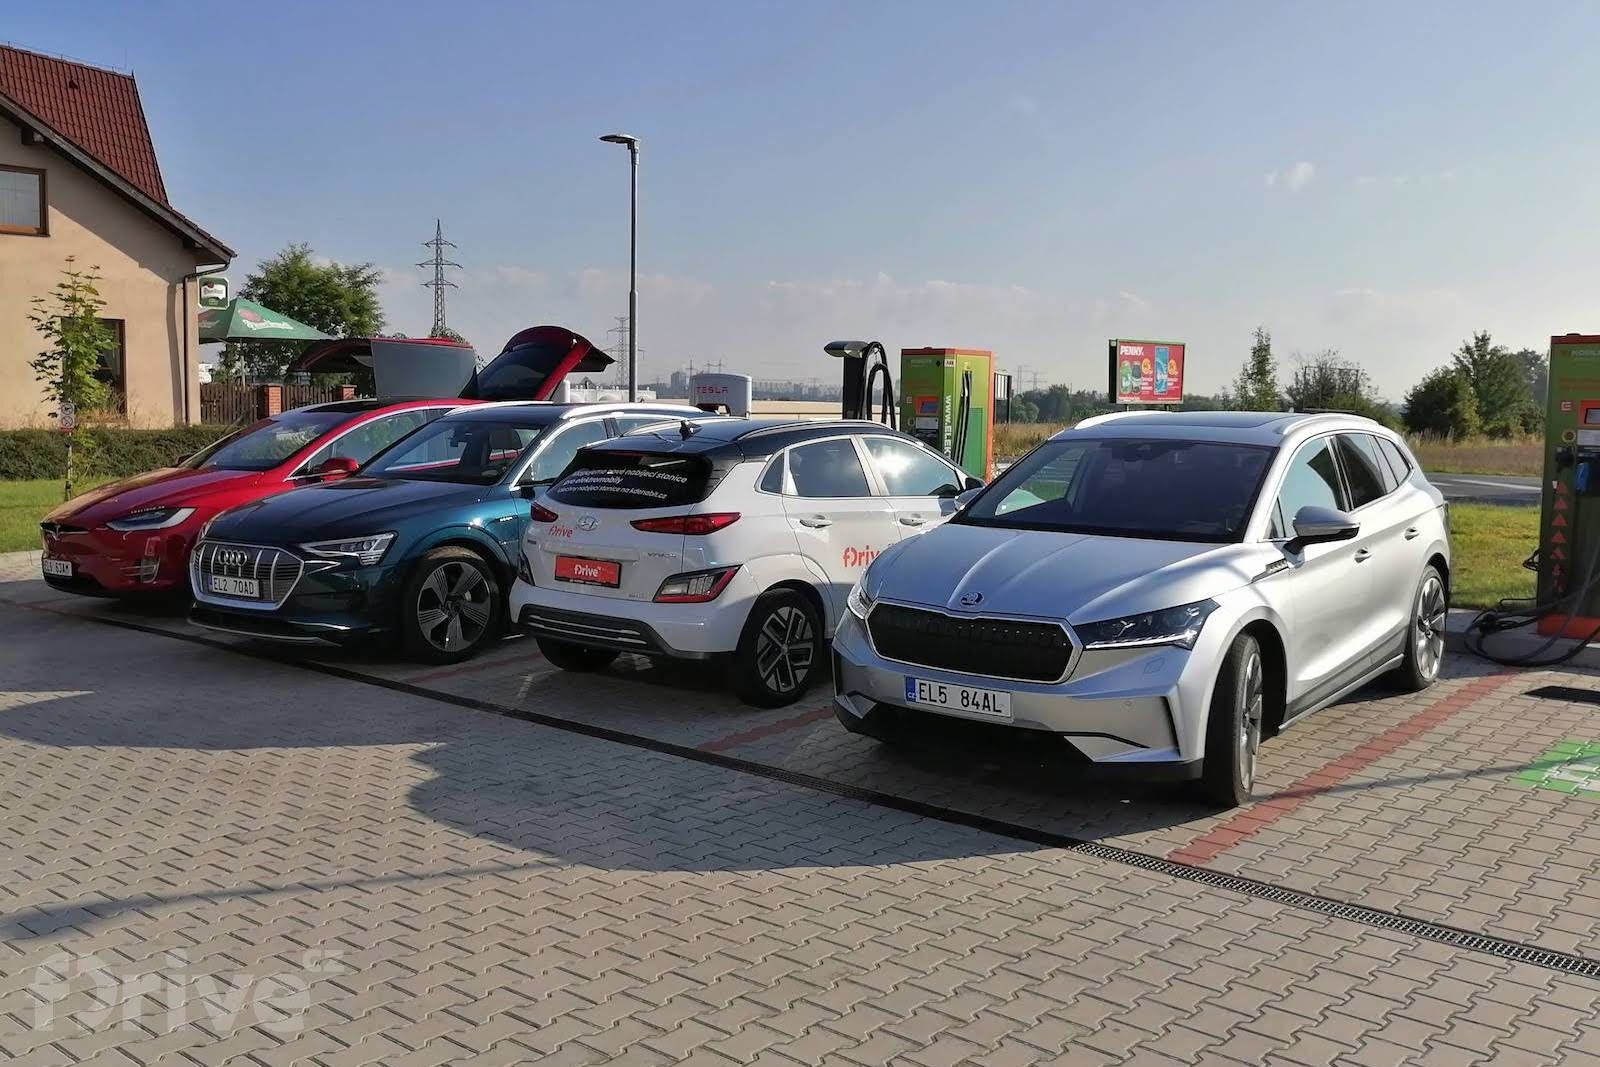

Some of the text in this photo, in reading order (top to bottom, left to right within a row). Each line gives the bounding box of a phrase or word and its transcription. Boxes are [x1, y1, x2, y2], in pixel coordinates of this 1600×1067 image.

[697, 386, 728, 394] TESLA
[842, 545, 880, 567] fDriv
[214, 577, 228, 592] EL2
[919, 682, 1002, 713] EL5 84AL
